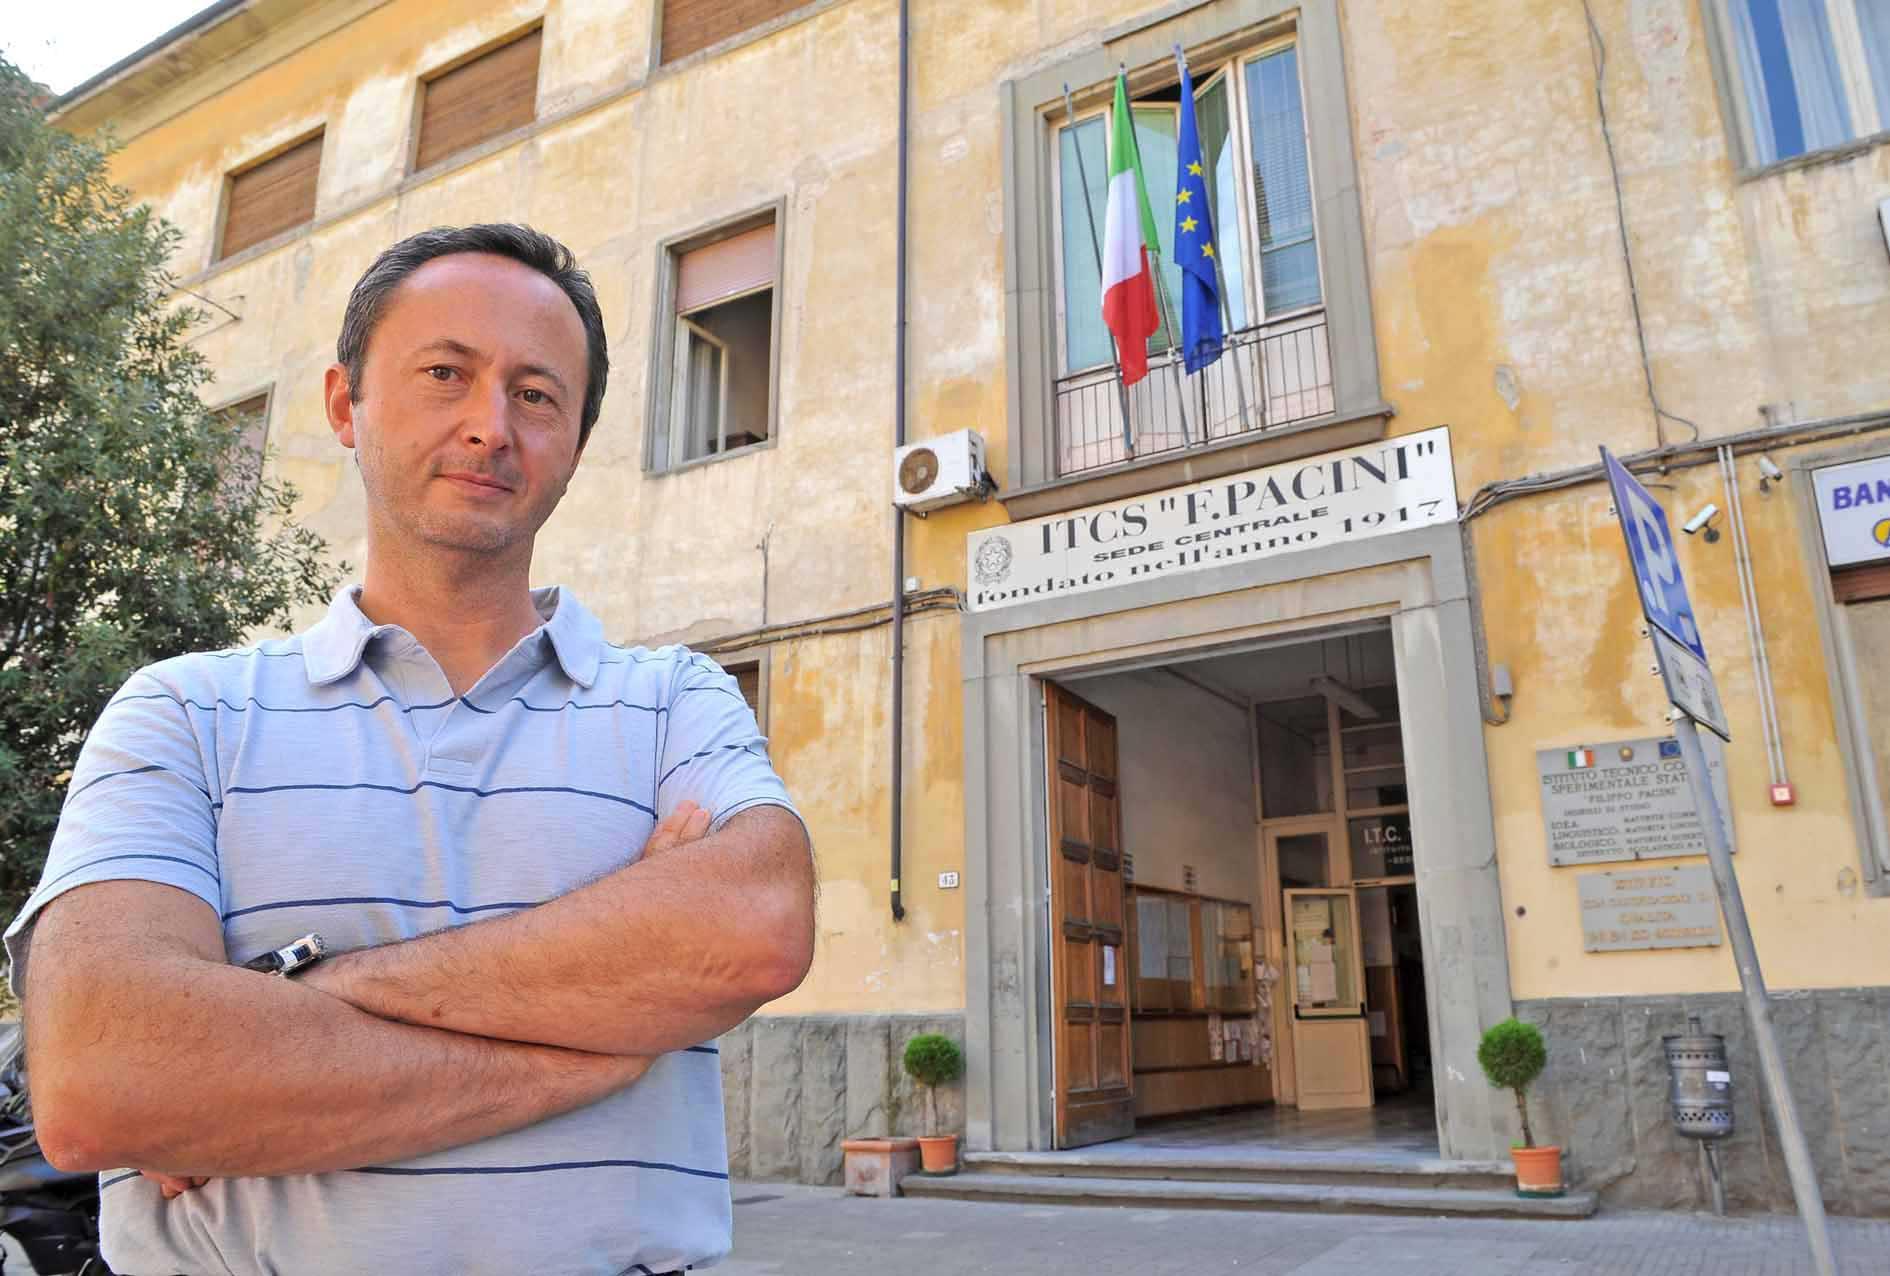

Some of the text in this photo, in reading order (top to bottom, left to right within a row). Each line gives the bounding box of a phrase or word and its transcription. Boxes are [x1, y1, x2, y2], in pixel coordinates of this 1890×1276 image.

[976, 499, 1442, 605] fondato nell'anno 1917
[1040, 503, 1148, 556] ITCS
[1093, 506, 1330, 563] SEDE CENTRALE
[1551, 771, 1689, 795] SPERIMENTALE STAT
[1603, 762, 1659, 779] TECNICO
